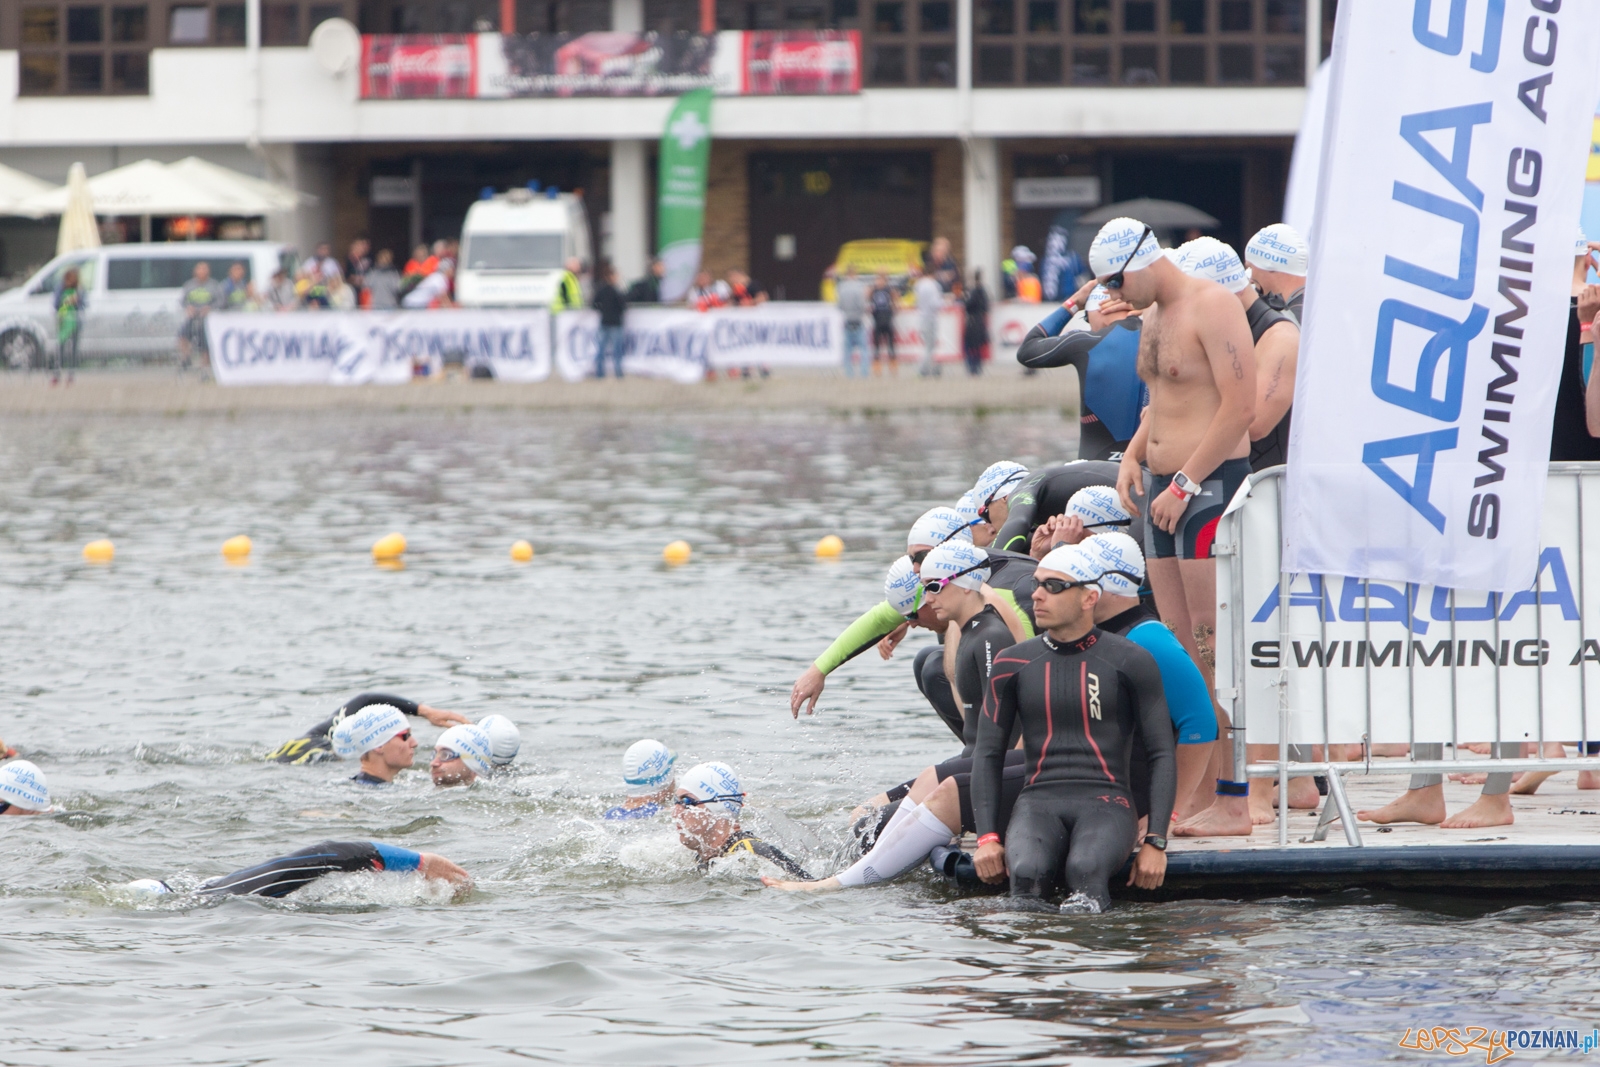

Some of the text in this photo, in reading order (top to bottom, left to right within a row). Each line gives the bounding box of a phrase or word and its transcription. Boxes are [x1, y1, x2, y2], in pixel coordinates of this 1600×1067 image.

[1100, 228, 1135, 246] AQUA
[1257, 237, 1298, 254] SPEED
[1194, 251, 1230, 271] AQUA
[1247, 246, 1289, 265] TRITOUR
[1361, 101, 1493, 535] AQUA
[1467, 146, 1543, 540] SWIMMING
[1083, 489, 1113, 505] AQUA
[1091, 537, 1123, 558] AQUA
[1099, 550, 1139, 577] SPEED
[890, 571, 918, 589] AQUA
[1250, 639, 1550, 668] SWIMMING
[1088, 672, 1102, 720] 2XU
[360, 719, 401, 746] TRITOUR
